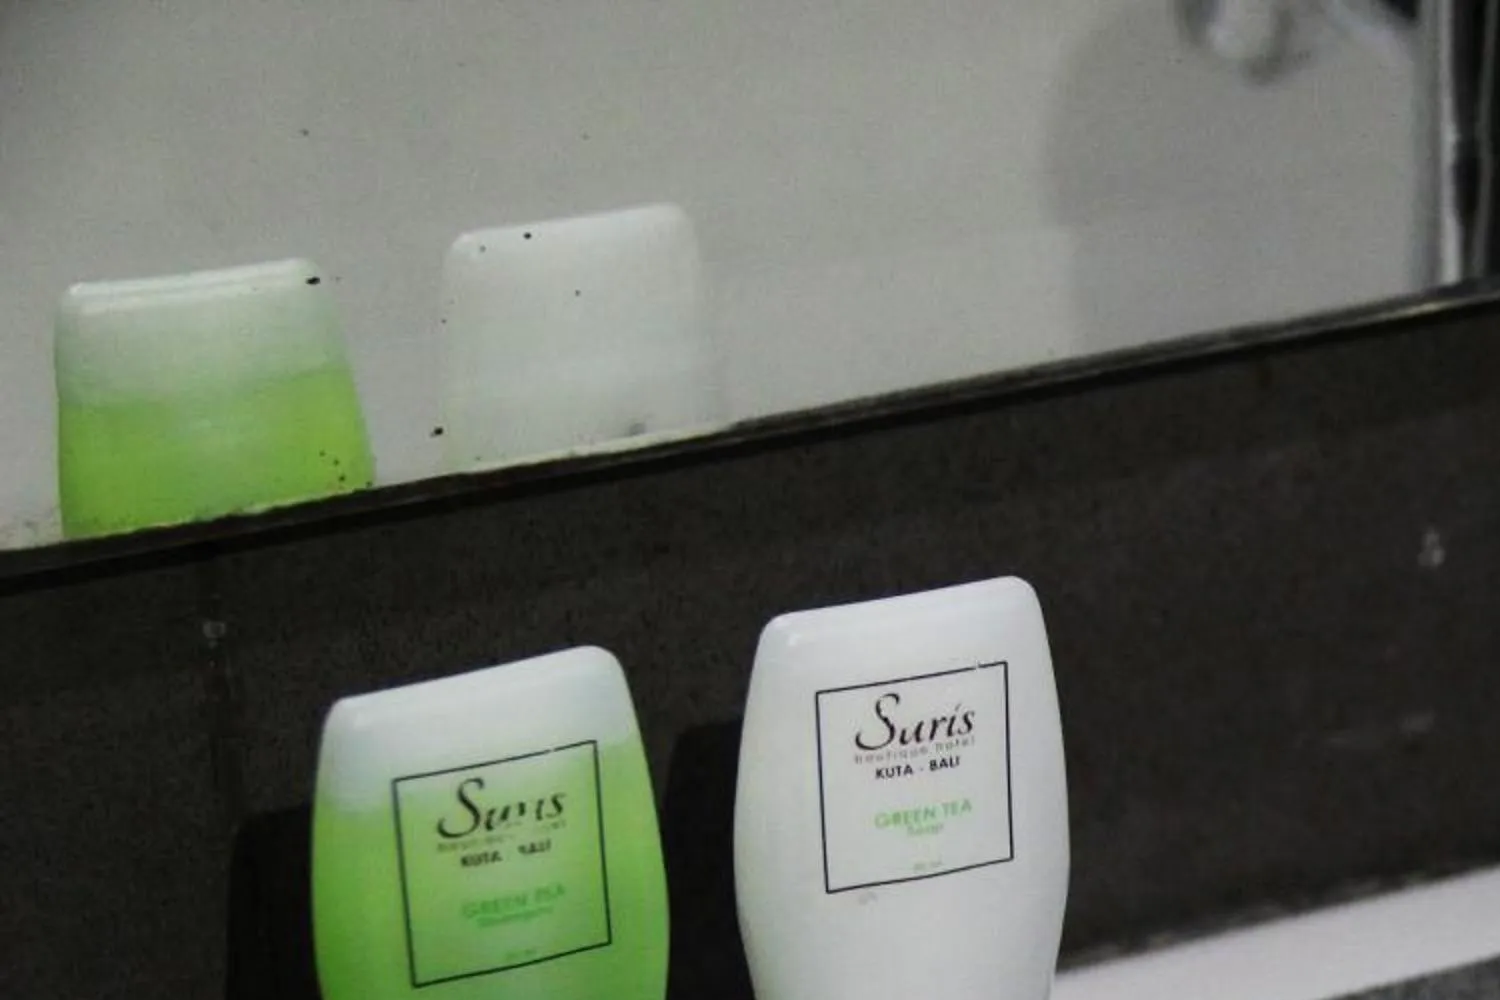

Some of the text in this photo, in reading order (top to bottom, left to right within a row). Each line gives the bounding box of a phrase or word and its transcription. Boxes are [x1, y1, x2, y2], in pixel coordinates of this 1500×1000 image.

[855, 693, 976, 751] Suris
[875, 763, 914, 780] KUTA
[929, 755, 961, 772] BALI
[875, 798, 973, 829] GREEN TEA
